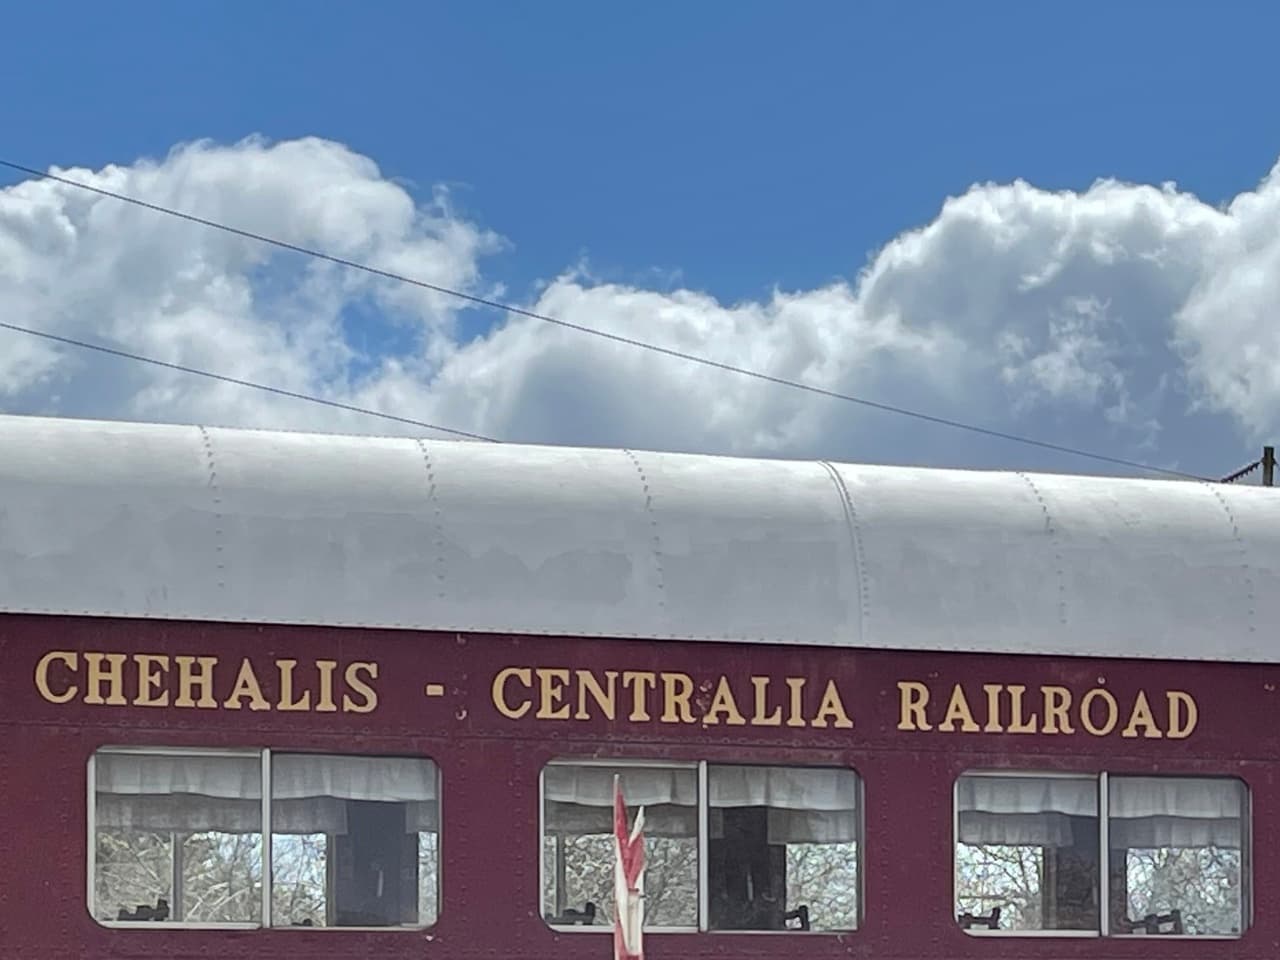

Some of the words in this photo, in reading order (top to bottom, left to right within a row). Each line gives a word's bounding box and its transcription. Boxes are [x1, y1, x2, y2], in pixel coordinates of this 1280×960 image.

[35, 651, 379, 713] CHEHALIS
[491, 667, 854, 729] CENTRALIA
[897, 681, 1199, 740] RAILROAD
